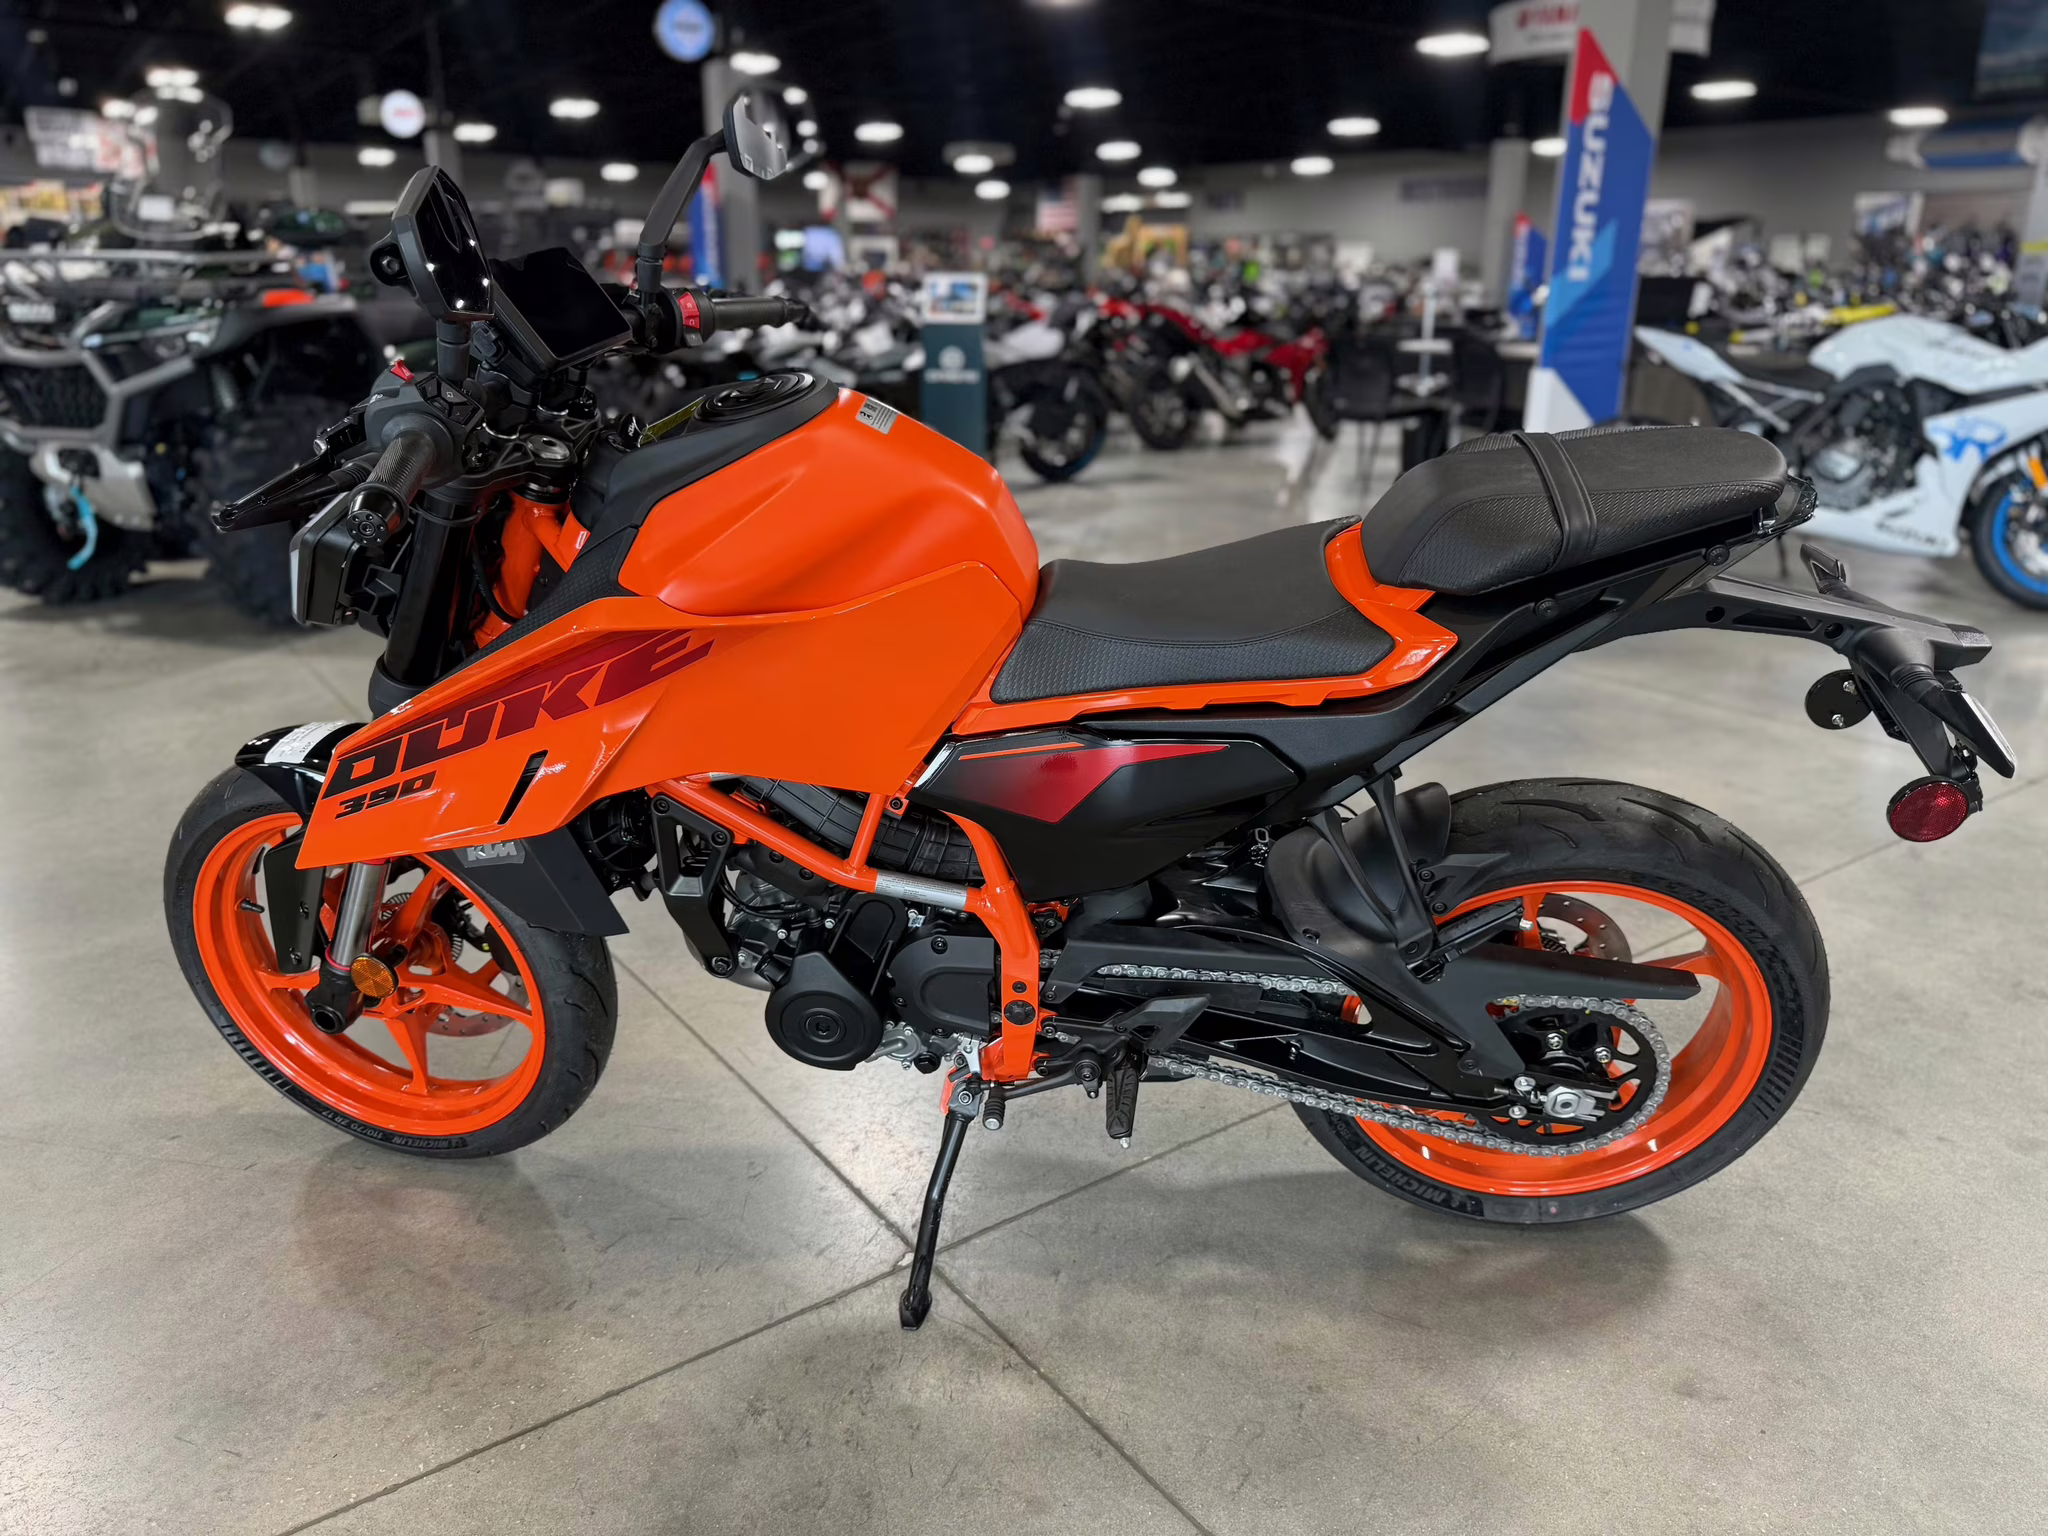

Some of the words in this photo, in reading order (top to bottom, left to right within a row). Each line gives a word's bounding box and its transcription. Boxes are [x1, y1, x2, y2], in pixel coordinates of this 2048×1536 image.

[1567, 70, 1616, 283] SUZUKI
[321, 628, 716, 800] DUKE
[335, 770, 438, 819] 390
[466, 841, 517, 861] KTM
[321, 1109, 335, 1120] 17
[335, 1115, 350, 1126] ZR
[350, 1122, 384, 1140] 110/70
[392, 1135, 449, 1149] MICHELIN
[1355, 1145, 1448, 1203] MICHELIN
